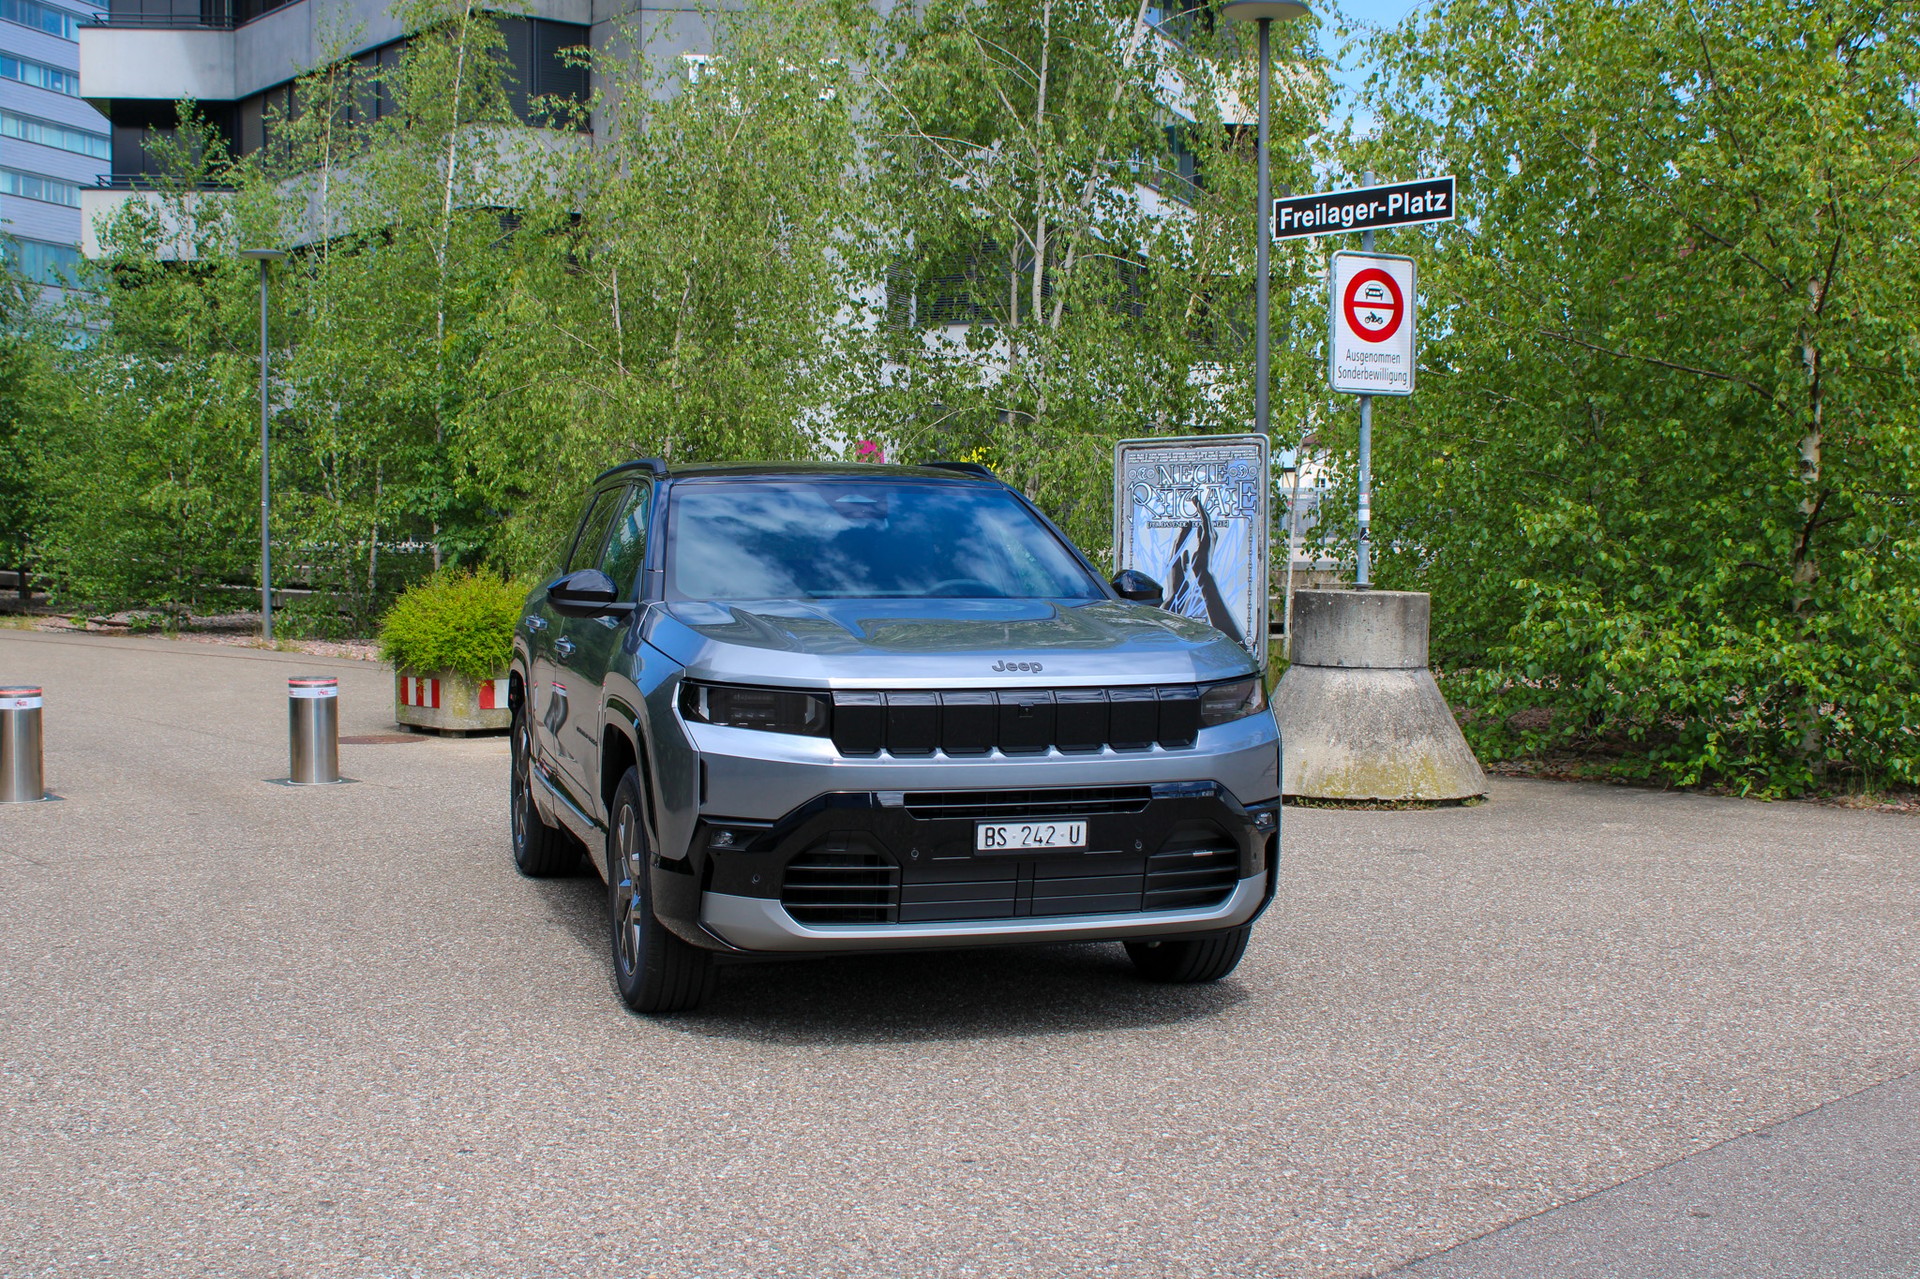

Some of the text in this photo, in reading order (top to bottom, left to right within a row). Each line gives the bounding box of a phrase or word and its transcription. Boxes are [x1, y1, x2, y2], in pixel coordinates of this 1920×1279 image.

[1279, 190, 1447, 230] Freilager-Platz
[1345, 348, 1401, 365] Ausgenommen
[1337, 365, 1408, 386] Sonderbewilligung
[1155, 462, 1229, 486] NEUE
[991, 659, 1044, 674] Jeep
[984, 824, 1081, 848] BS 242 U
